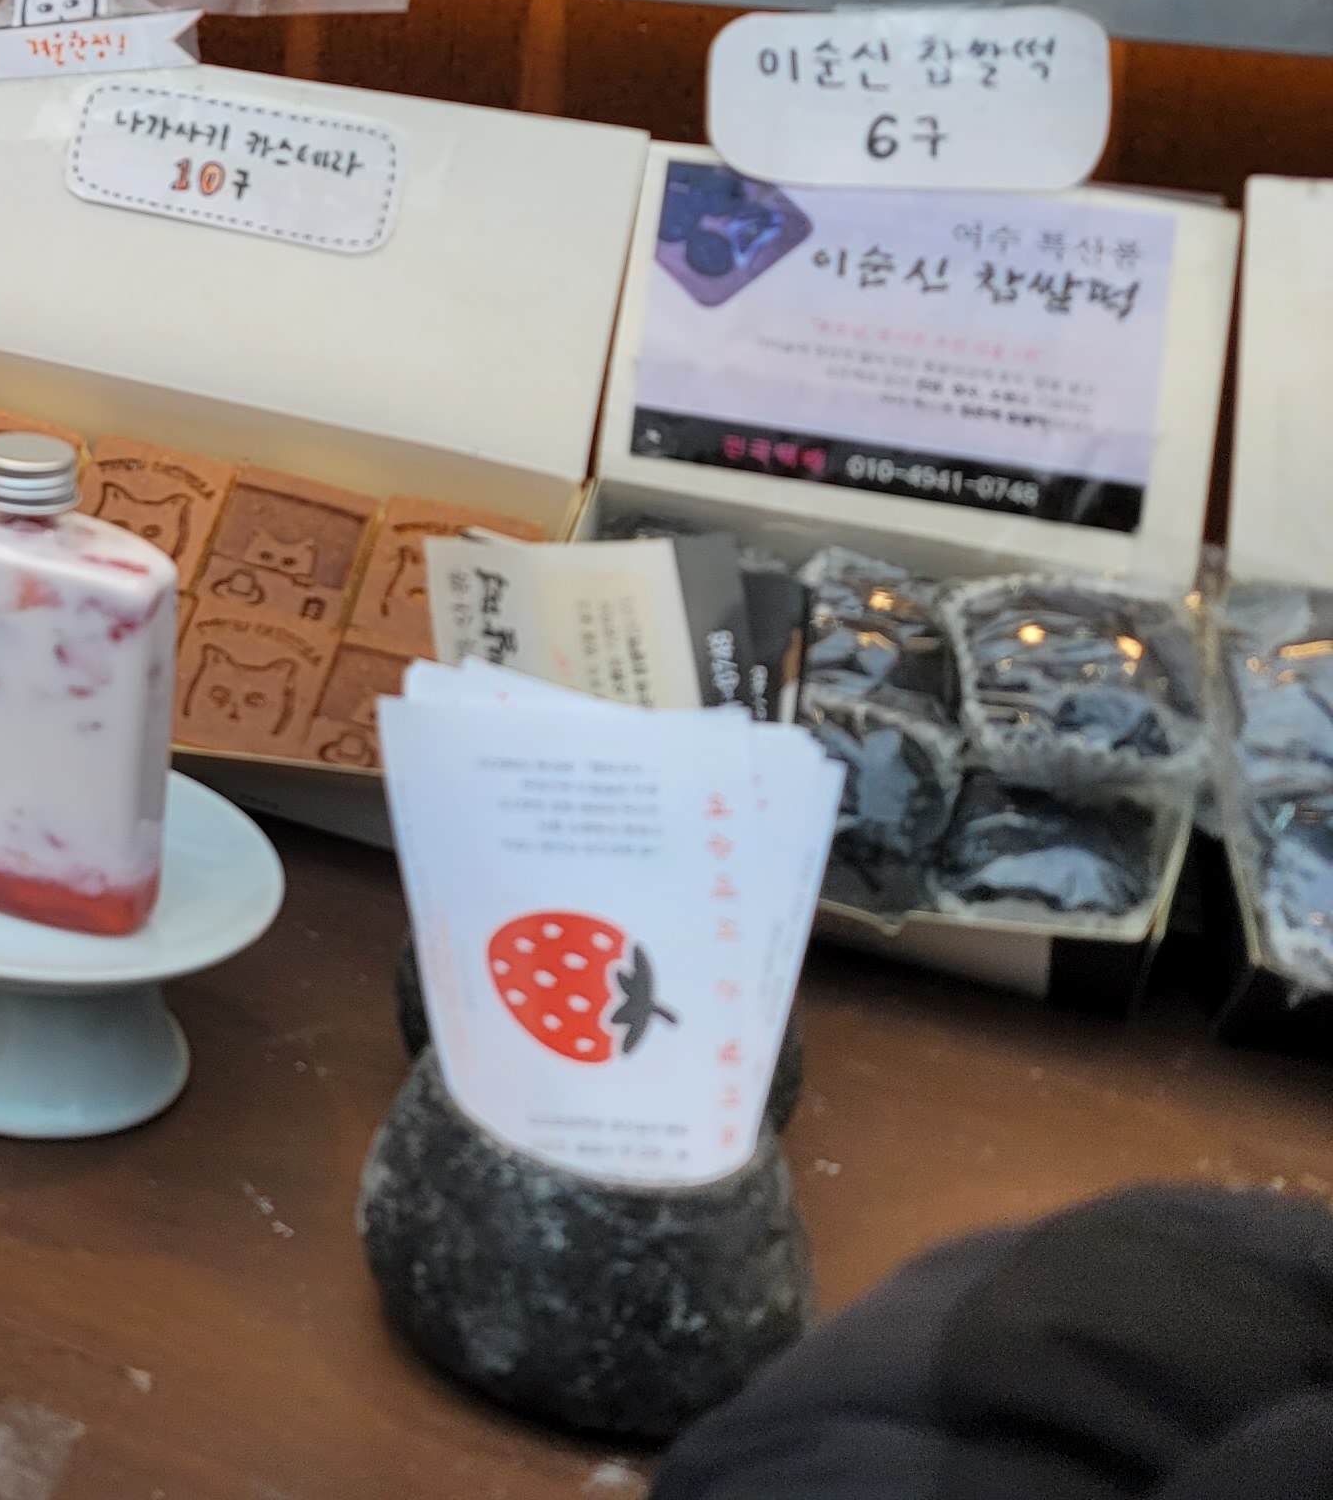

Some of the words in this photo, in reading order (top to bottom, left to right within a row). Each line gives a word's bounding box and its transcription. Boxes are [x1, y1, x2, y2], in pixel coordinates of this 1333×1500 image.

[759, 39, 892, 92] 이순신
[916, 33, 1058, 90] 찹쌀떡
[115, 109, 229, 151] 나가사키
[245, 130, 364, 178] 카스테라
[866, 113, 951, 162] 6구
[171, 158, 252, 200] 10구
[953, 221, 1022, 252] 여수
[1037, 225, 1143, 265] 특산품
[812, 244, 951, 296] 이순신
[974, 259, 1142, 322] 찹쌀떡
